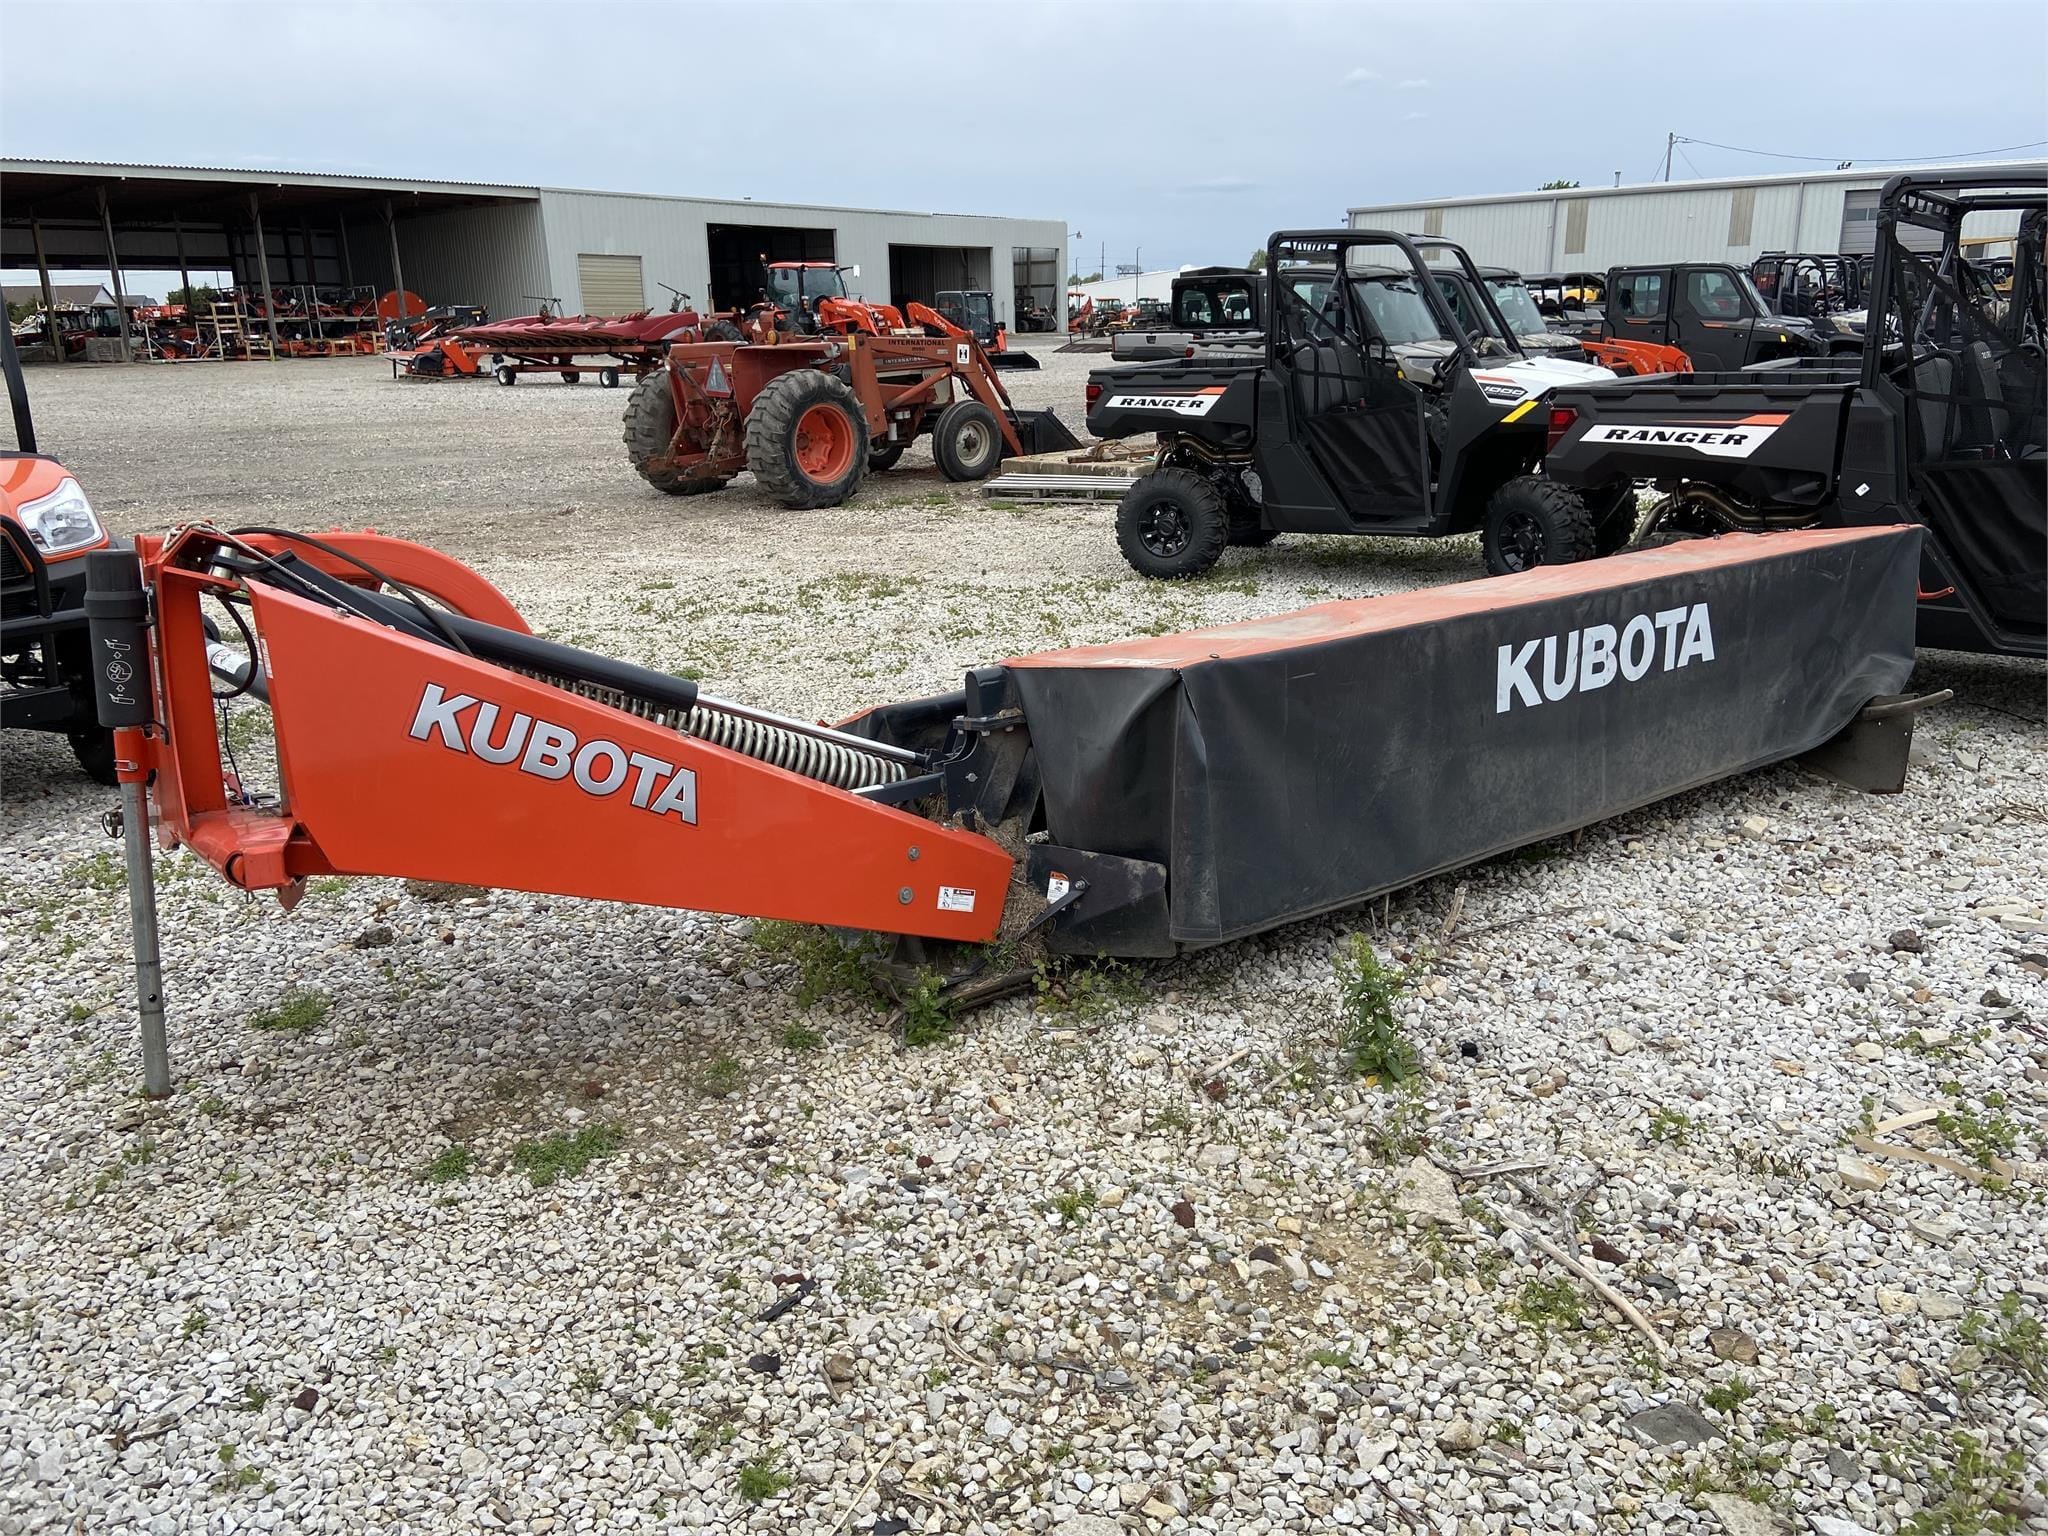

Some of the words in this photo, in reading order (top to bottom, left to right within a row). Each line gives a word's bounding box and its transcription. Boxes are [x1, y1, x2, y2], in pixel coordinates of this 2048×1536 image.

[1484, 386, 1525, 395] 1000
[1120, 398, 1205, 409] RANGER
[1604, 429, 1748, 446] RANGER
[1496, 603, 1715, 714] KUBOTA
[408, 681, 700, 826] KUBOTA
